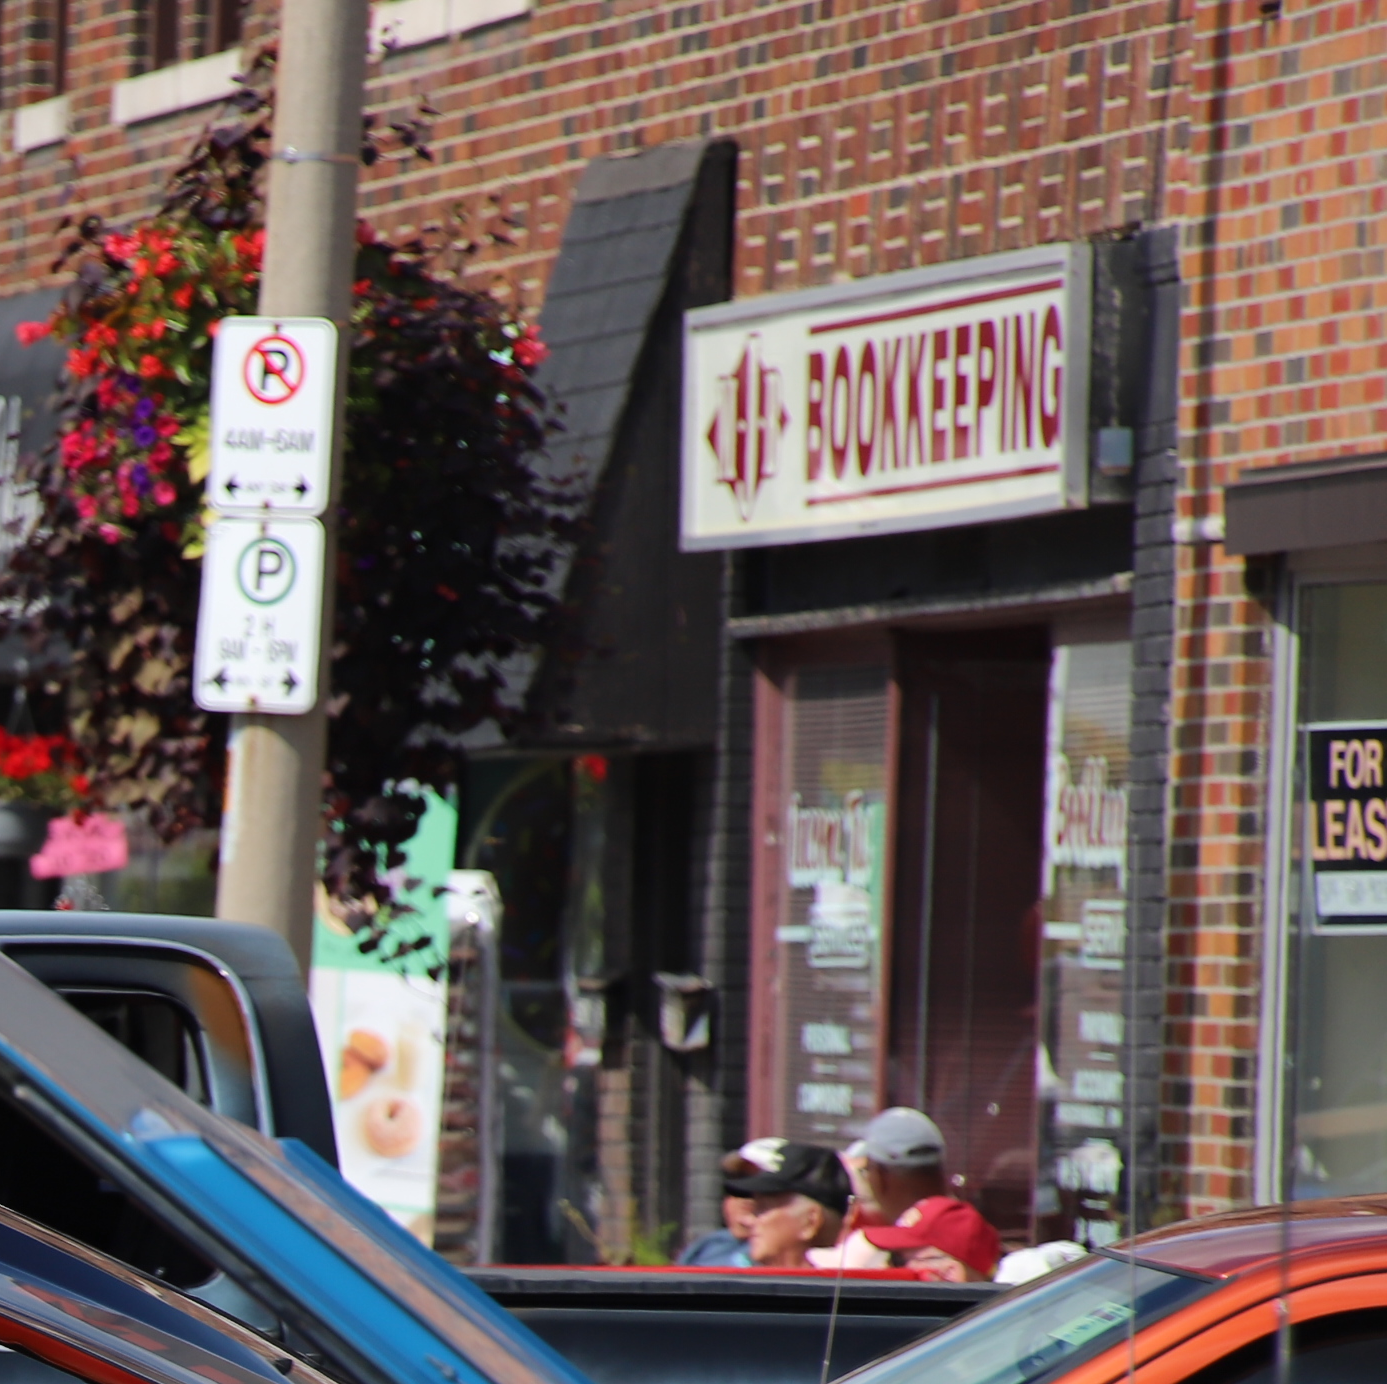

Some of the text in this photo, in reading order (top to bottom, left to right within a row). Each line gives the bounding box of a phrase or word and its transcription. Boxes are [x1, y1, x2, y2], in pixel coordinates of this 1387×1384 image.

[805, 305, 1063, 481] BOOKKEEPING
[1329, 739, 1383, 789] FOR
[1310, 797, 1387, 861] LEAS
